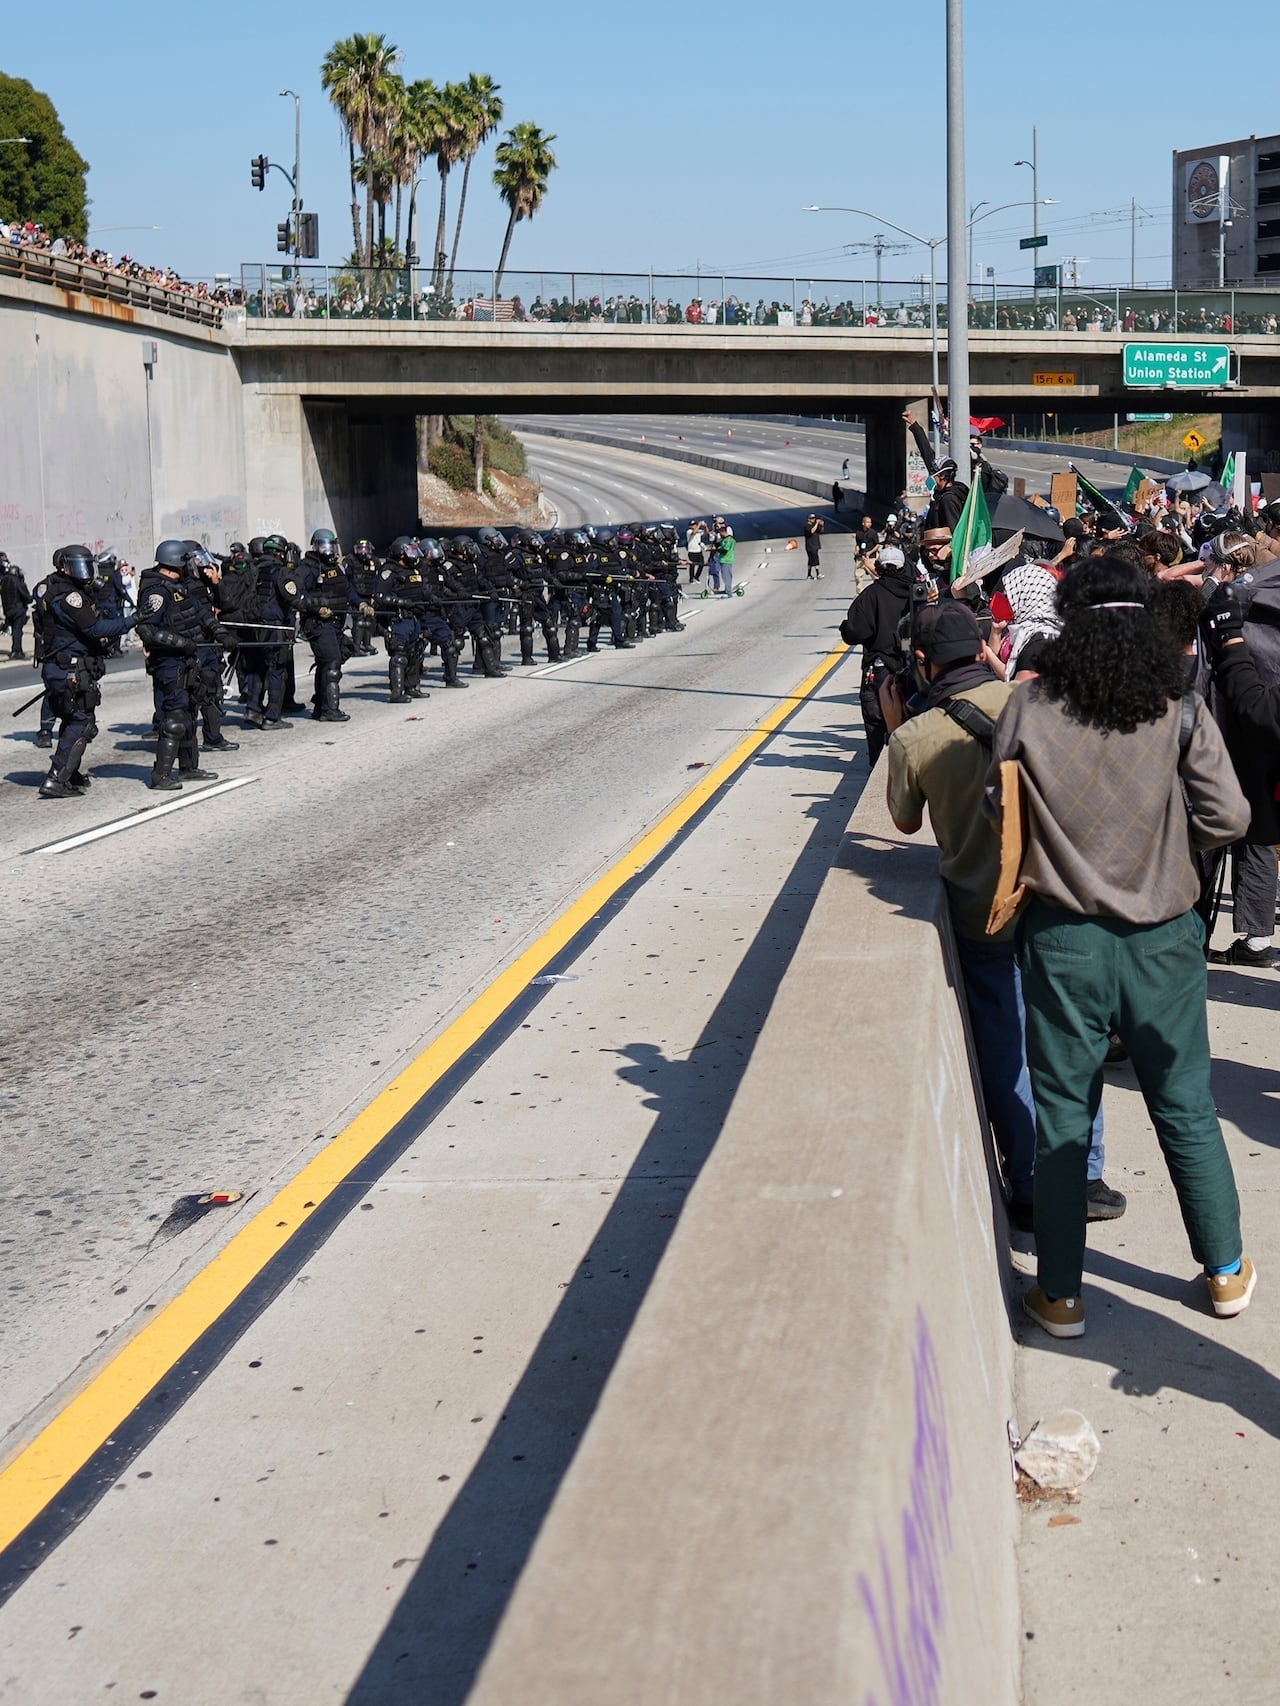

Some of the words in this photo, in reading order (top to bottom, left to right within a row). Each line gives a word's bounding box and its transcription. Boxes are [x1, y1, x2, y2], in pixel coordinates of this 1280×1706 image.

[1134, 351, 1188, 363] Alameda
[1194, 351, 1208, 363] St
[1129, 366, 1164, 379] Union
[1168, 366, 1212, 379] Station
[1036, 375, 1045, 384] 15
[1058, 375, 1064, 384] 6
[1216, 611, 1231, 621] FTP
